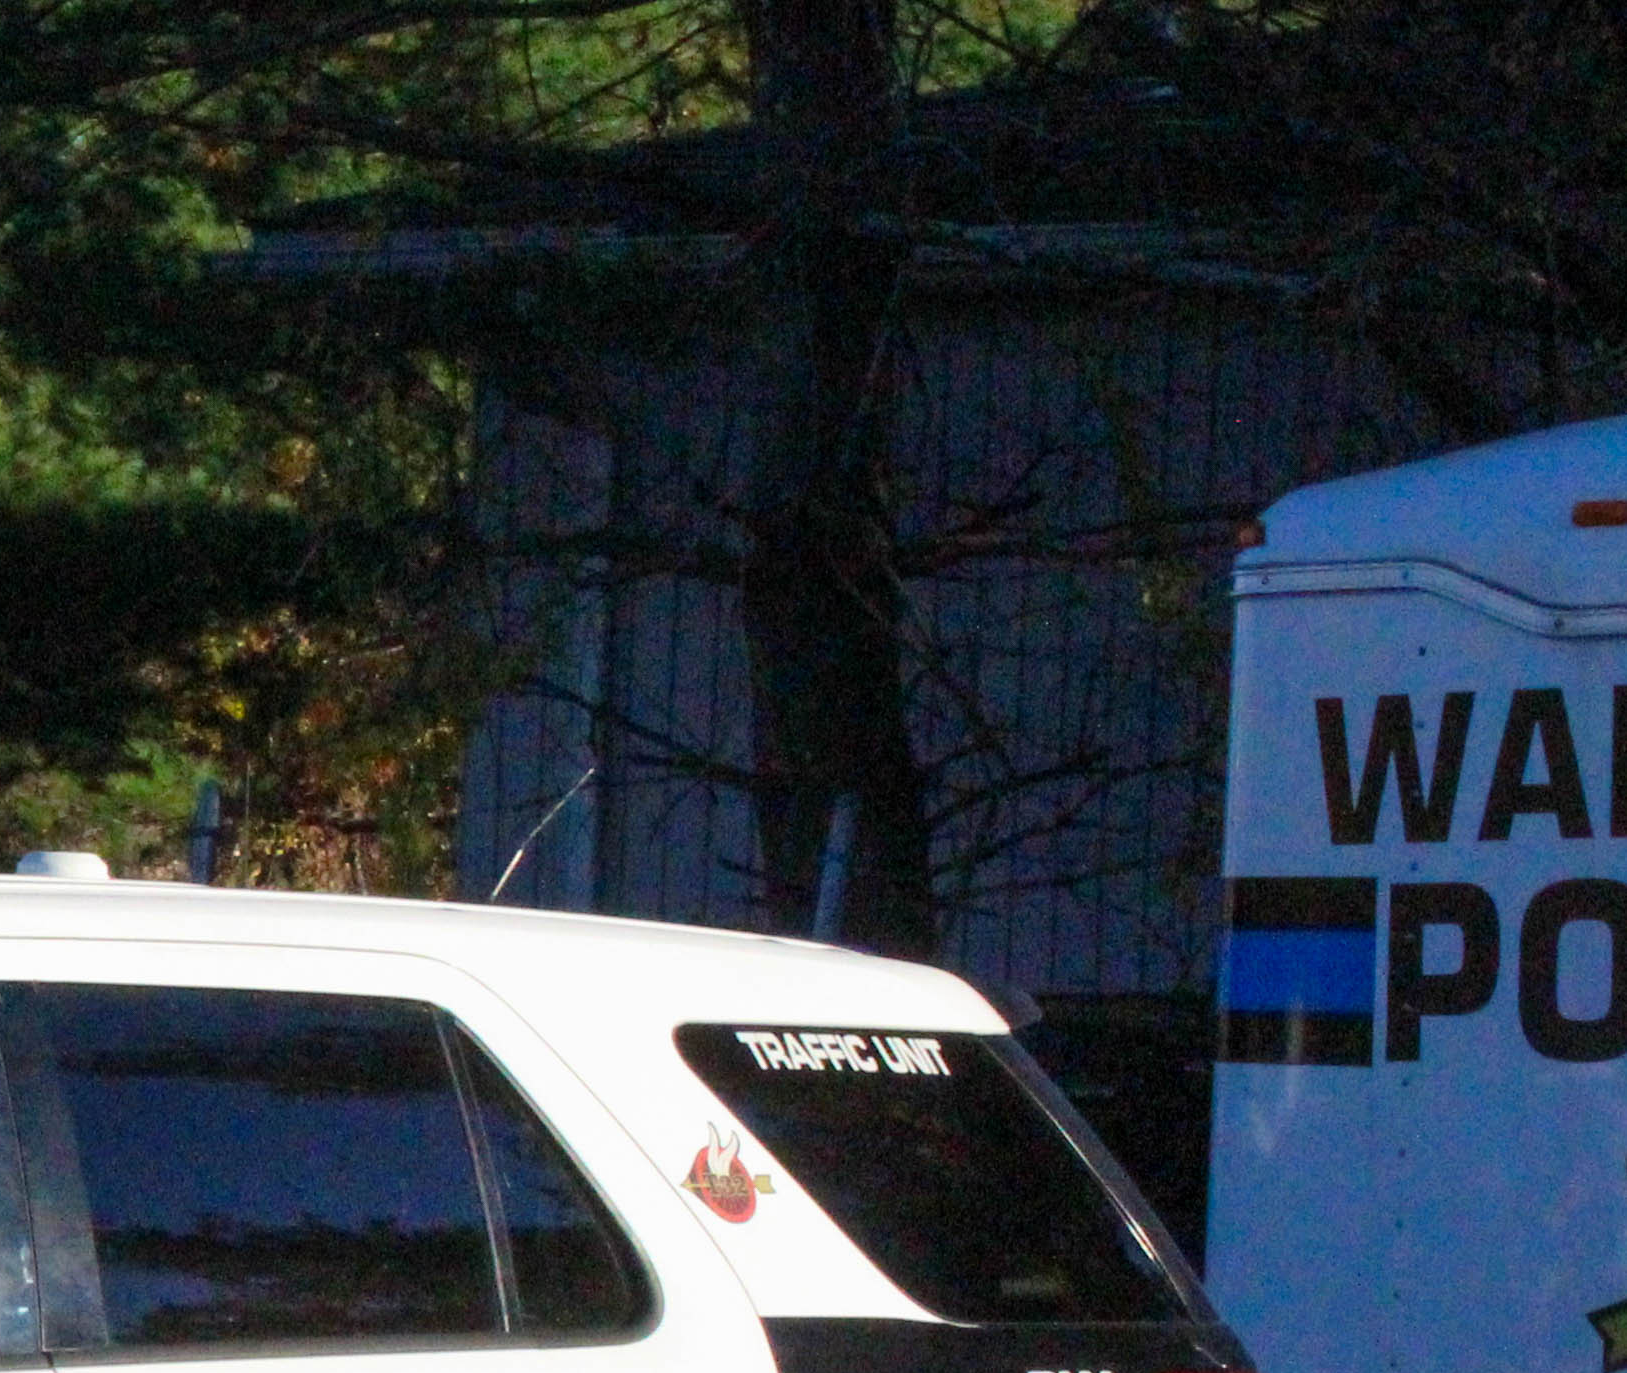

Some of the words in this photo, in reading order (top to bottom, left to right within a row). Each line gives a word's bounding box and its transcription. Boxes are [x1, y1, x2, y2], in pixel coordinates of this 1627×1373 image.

[1315, 684, 1627, 846] WA
[735, 1031, 877, 1074] TRAFFIC
[871, 1035, 951, 1076] UNIT
